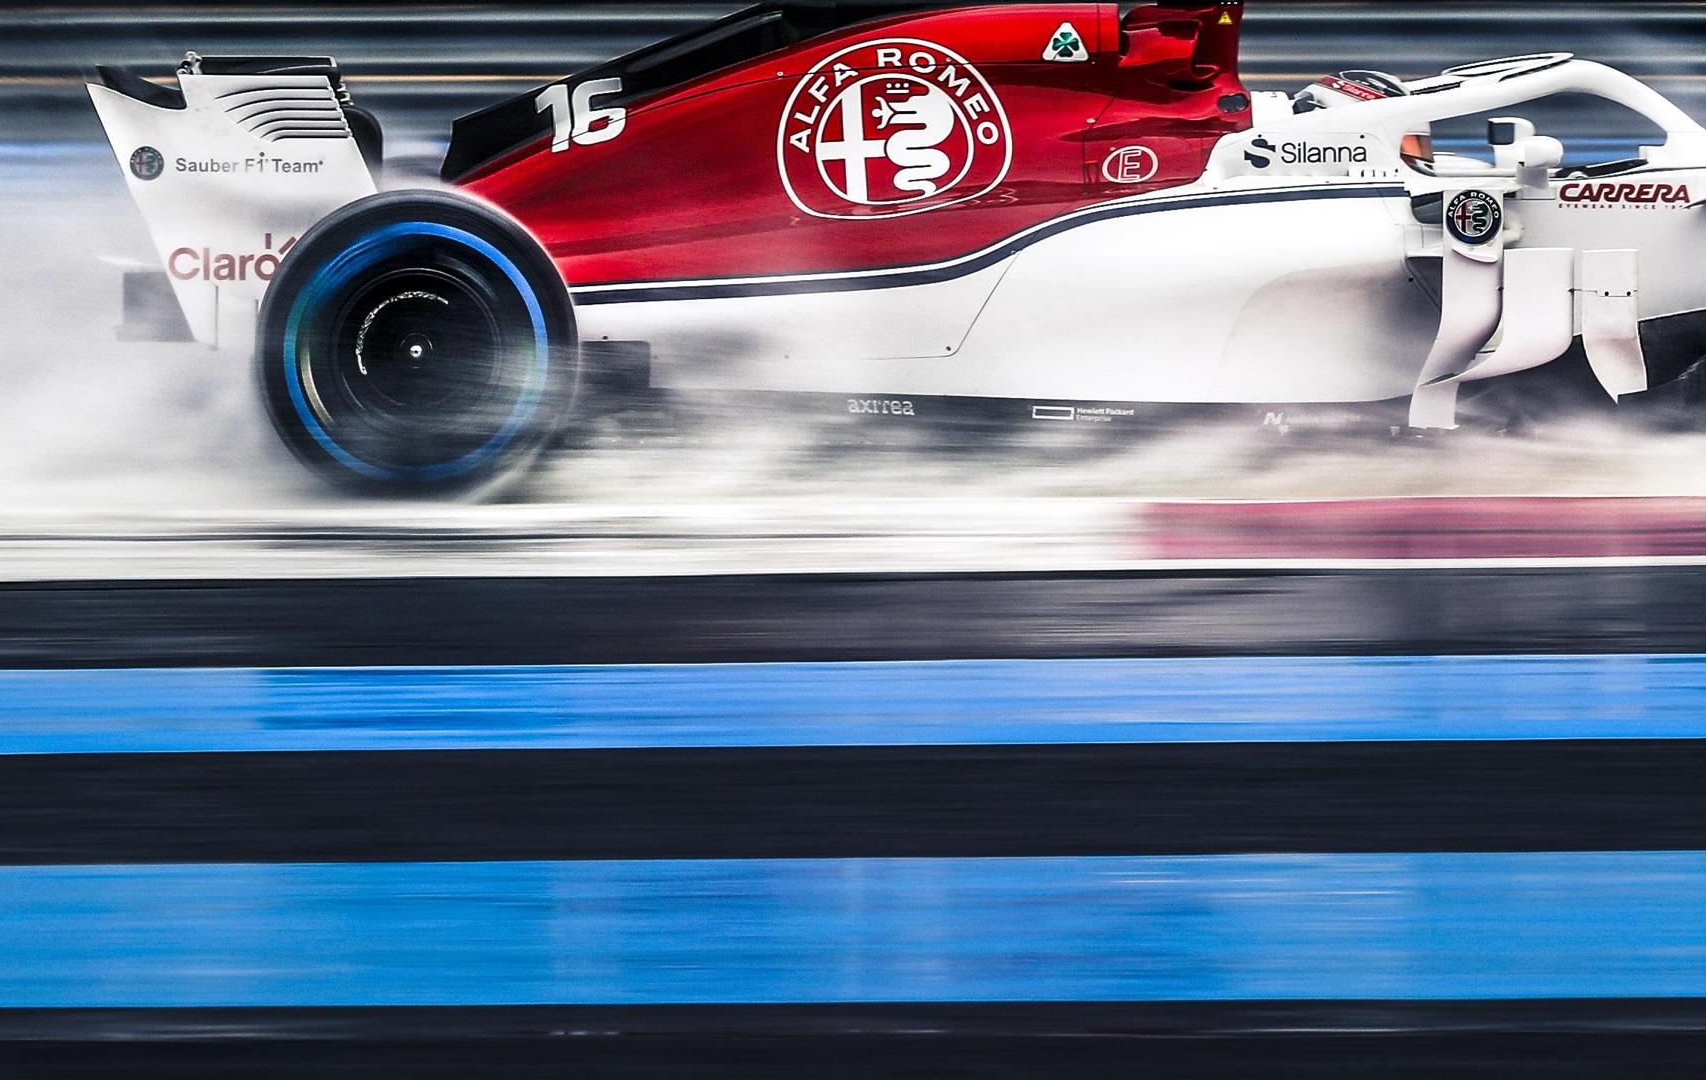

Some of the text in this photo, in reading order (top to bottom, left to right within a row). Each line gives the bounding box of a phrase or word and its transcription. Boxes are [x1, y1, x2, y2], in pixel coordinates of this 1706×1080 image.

[535, 77, 626, 152] 16
[789, 48, 999, 153] ALFA ROMEO
[175, 157, 238, 173] Sauber
[271, 157, 319, 173] Team
[1281, 141, 1367, 164] Silanna
[1559, 183, 1691, 203] CARRERA
[168, 247, 280, 281] Claro
